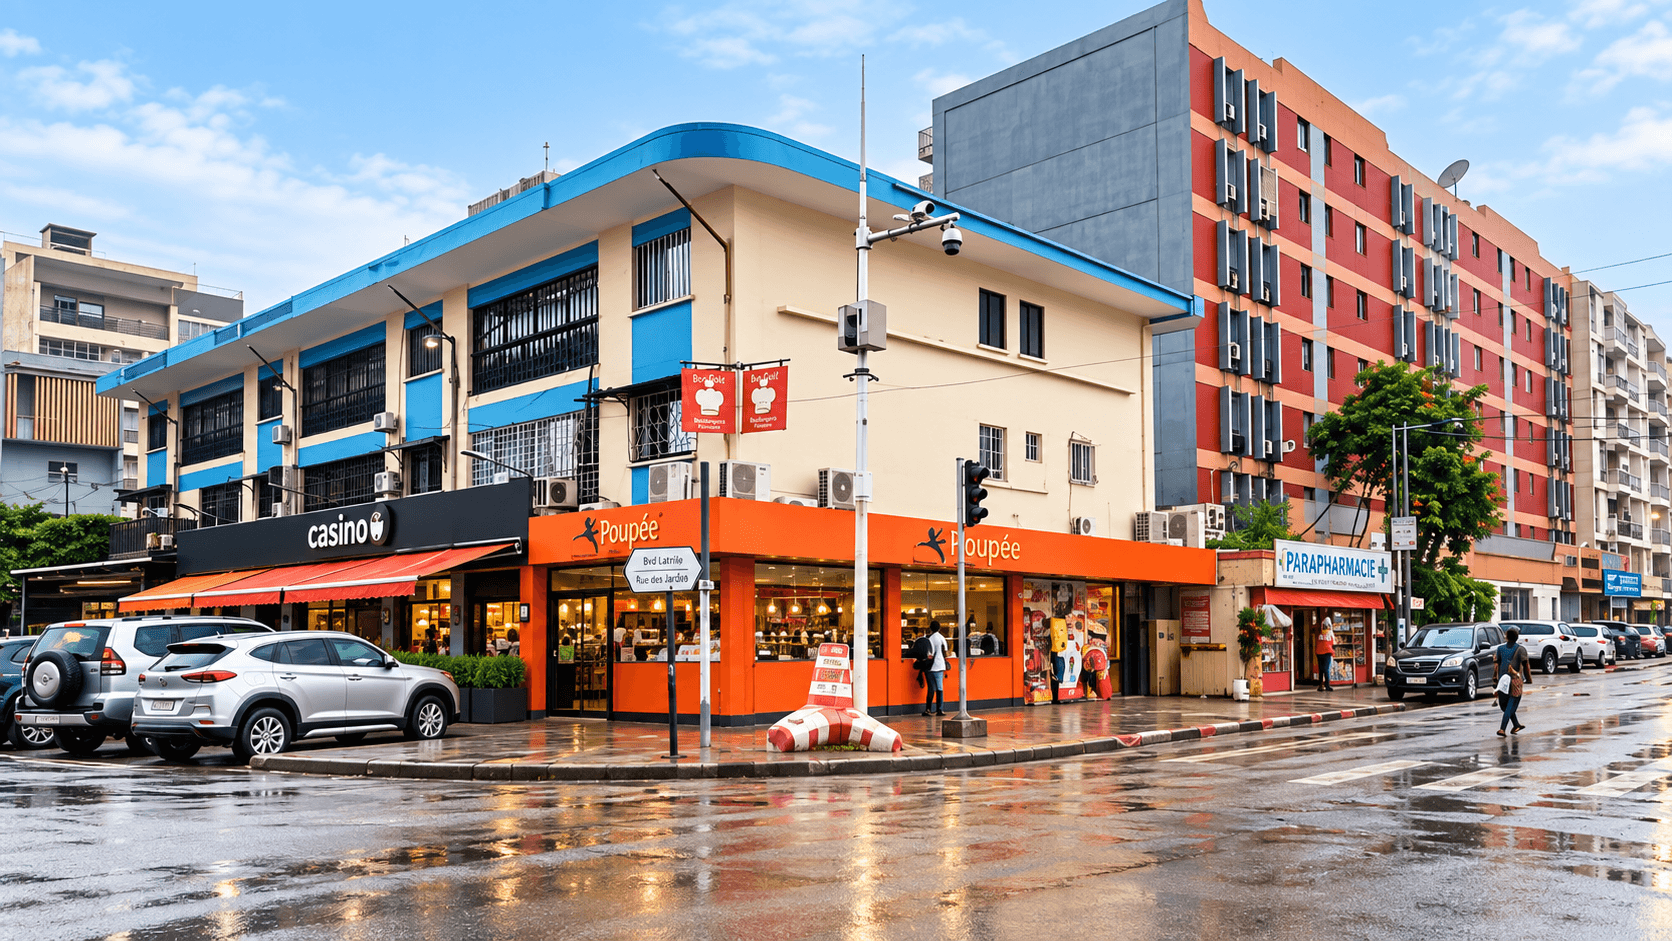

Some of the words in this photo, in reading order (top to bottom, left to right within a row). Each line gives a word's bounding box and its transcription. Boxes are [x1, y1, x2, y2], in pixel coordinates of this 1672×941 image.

[308, 513, 368, 549] casino
[600, 513, 659, 550] Poupée
[951, 530, 1021, 566] Poupée
[651, 575, 663, 583] des
[1286, 551, 1375, 578] PARAPHARMACIE
